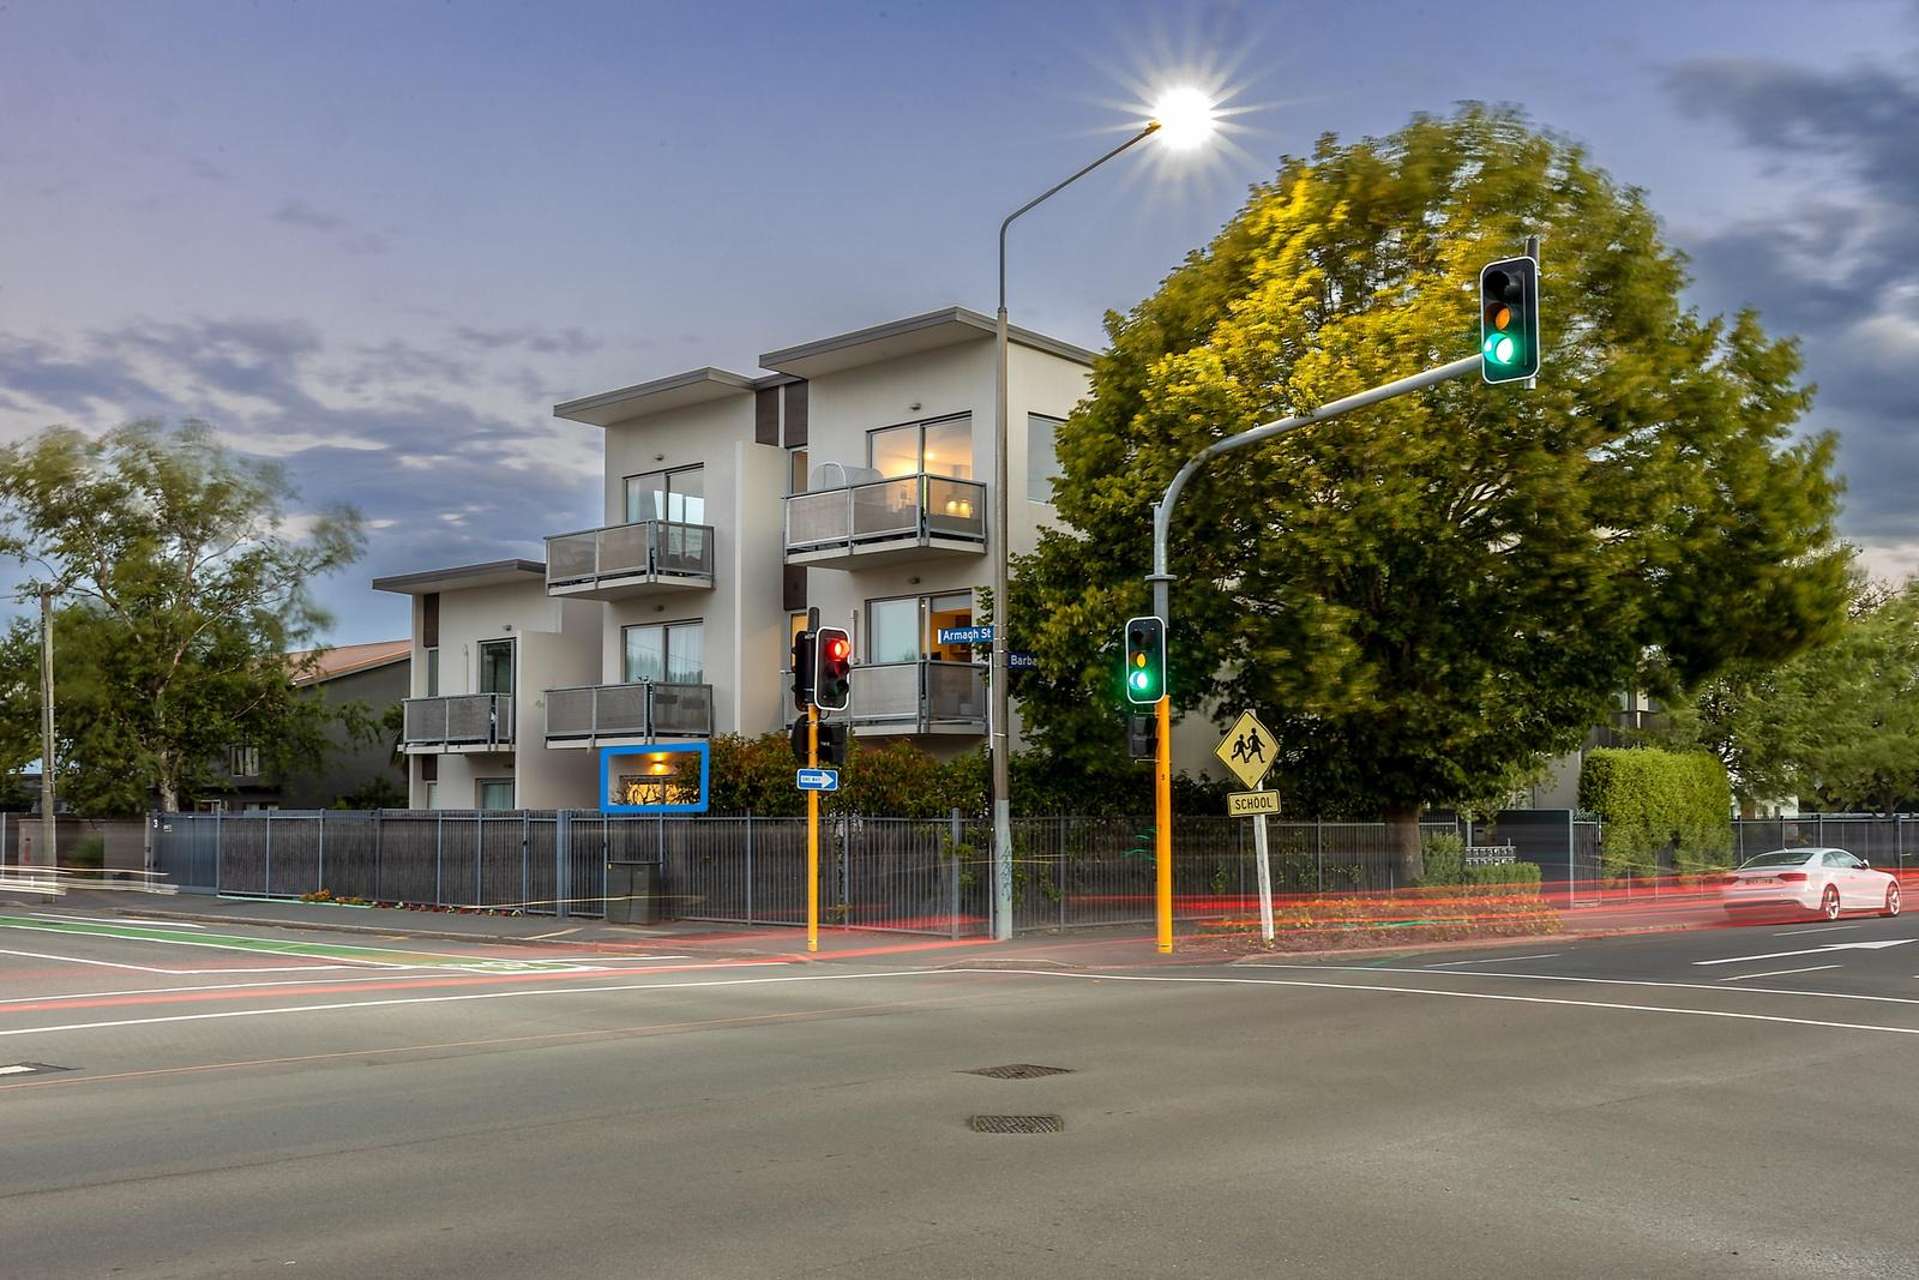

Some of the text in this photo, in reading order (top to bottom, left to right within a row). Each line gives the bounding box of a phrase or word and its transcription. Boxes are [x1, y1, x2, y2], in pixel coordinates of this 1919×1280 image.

[943, 628, 991, 642] Armagh St
[1235, 796, 1272, 810] SCHOOL
